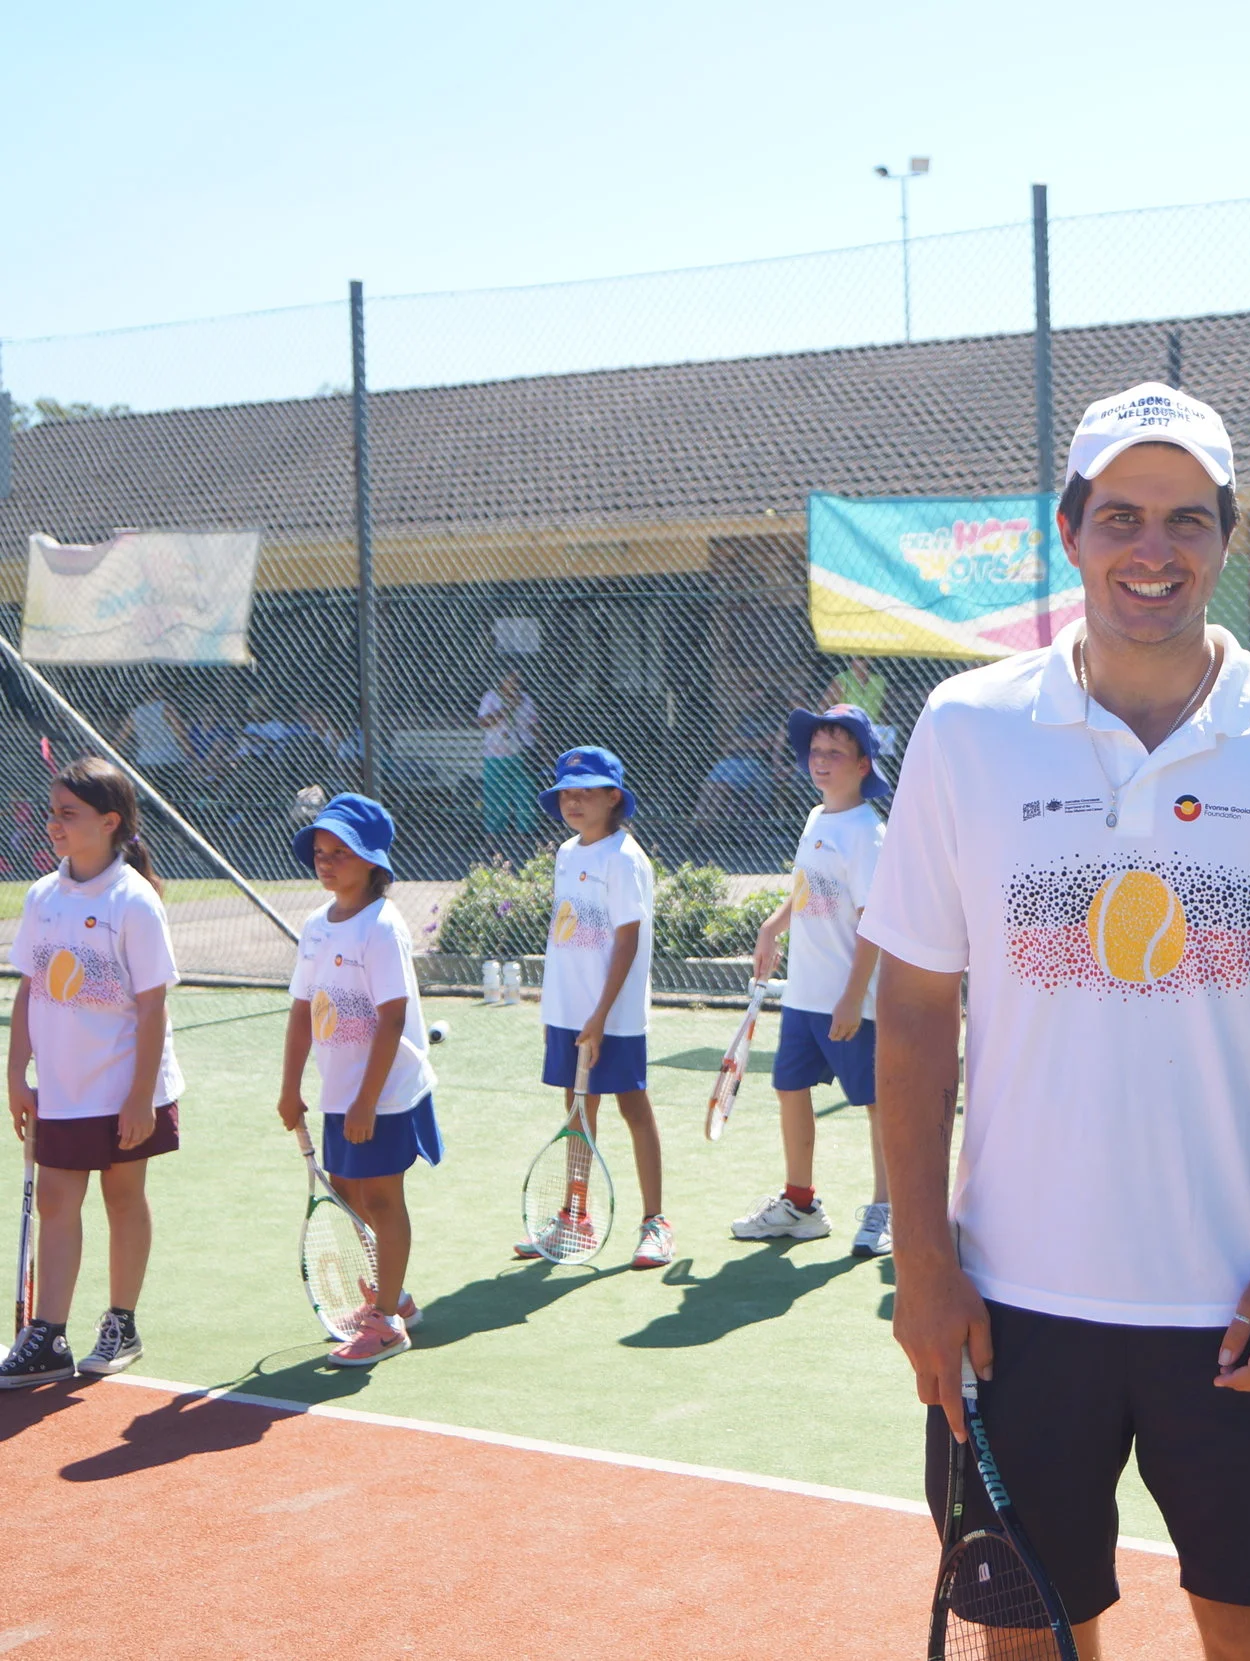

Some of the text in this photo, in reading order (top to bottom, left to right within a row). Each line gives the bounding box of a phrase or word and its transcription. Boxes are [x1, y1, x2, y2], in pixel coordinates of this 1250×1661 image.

[1117, 407, 1191, 422] MELBOURNE
[1140, 417, 1170, 427] 2017
[1204, 803, 1229, 812] Evonne
[1204, 811, 1242, 820] Foundation
